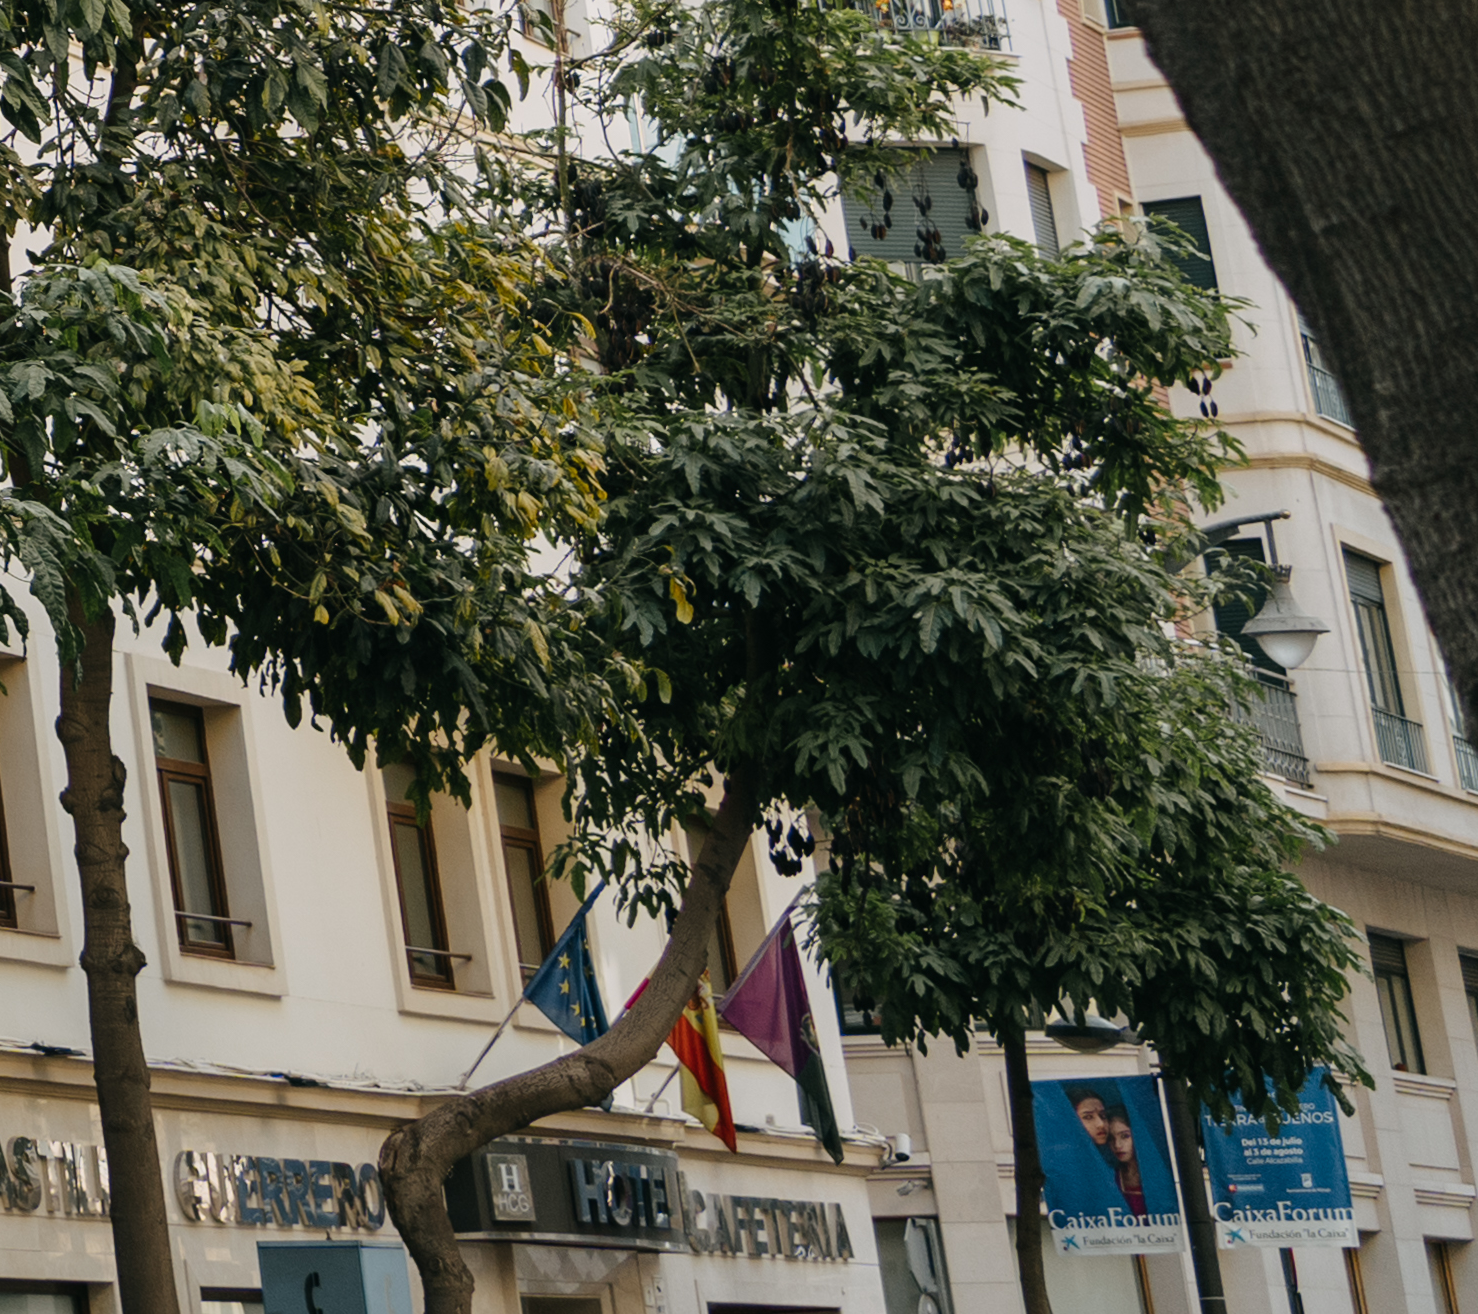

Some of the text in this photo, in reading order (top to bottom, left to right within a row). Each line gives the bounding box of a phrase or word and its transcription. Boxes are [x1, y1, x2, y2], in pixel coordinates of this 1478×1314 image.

[497, 1163, 521, 1193] H
[174, 1150, 386, 1231] GUERRERO
[497, 1194, 530, 1213] HCG
[1213, 1200, 1355, 1223] CaixaForum
[689, 1189, 855, 1260] CAFETERIA
[1048, 1206, 1181, 1230] CaixaForum
[1082, 1235, 1132, 1246] Fundación
[1249, 1228, 1302, 1239] Fundación
